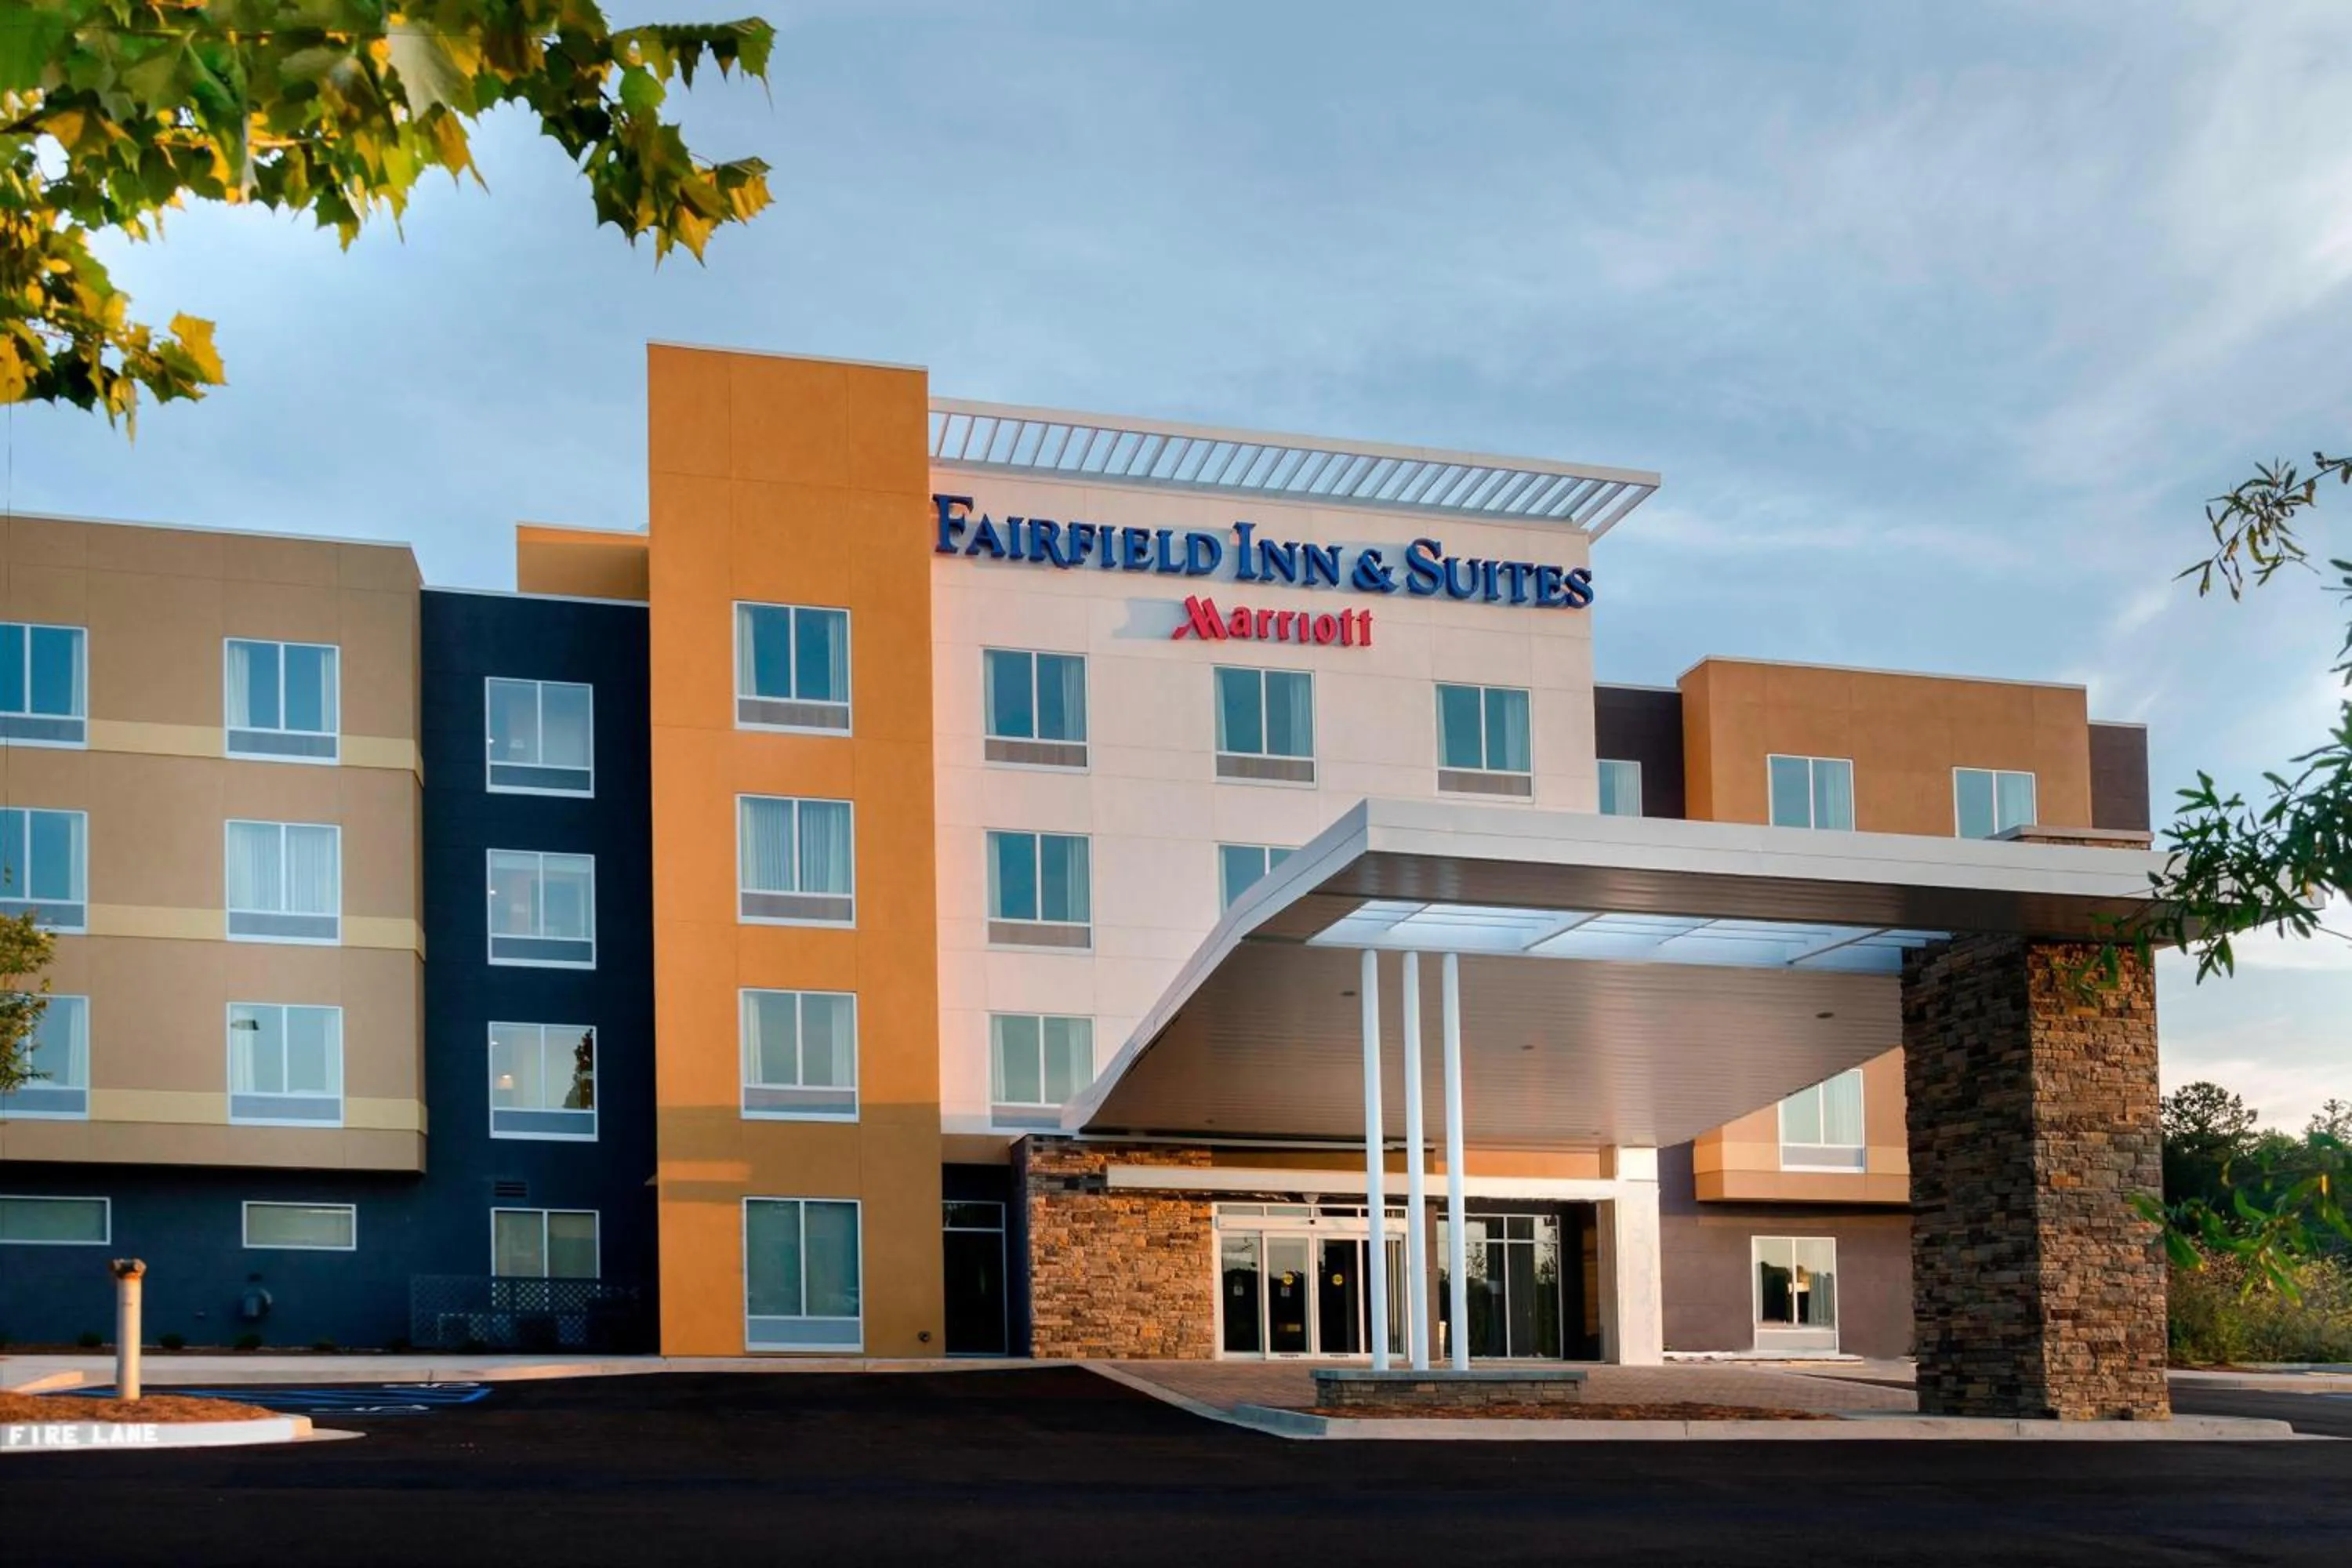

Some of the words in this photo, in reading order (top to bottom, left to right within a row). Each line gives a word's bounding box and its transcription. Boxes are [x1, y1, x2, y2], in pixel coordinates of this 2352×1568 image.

[932, 494, 1222, 576] FAIRFIELD
[1232, 521, 1342, 586] INN
[1352, 549, 1397, 593] &
[1406, 538, 1595, 609] SUITES
[1171, 594, 1373, 647] Marriott
[9, 1425, 77, 1445] FIRE
[93, 1424, 158, 1443] LANE
